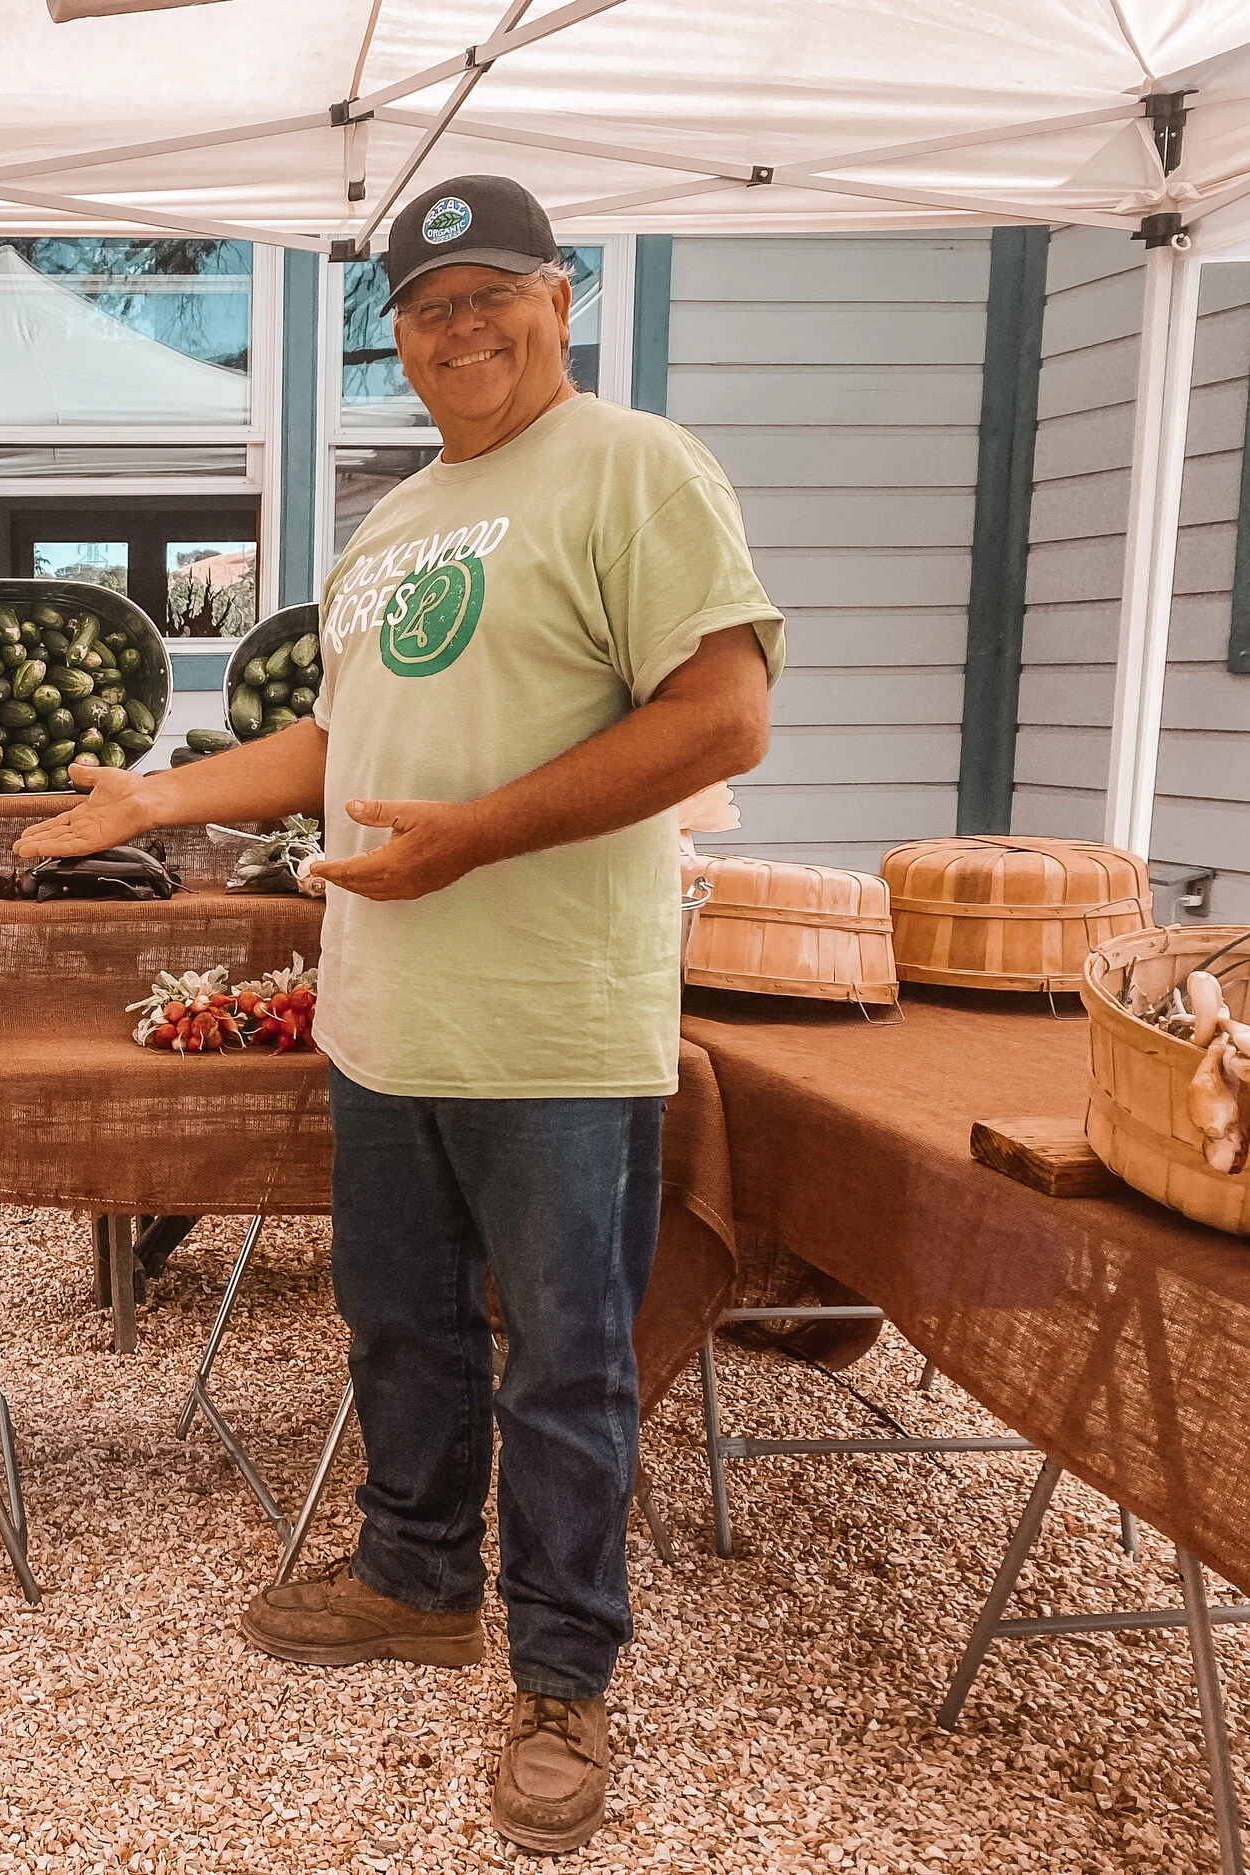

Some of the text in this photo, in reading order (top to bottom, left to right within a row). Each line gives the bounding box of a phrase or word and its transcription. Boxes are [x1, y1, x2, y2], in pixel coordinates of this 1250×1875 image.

[427, 200, 466, 226] REAL
[427, 219, 466, 238] ORGANIC
[343, 516, 510, 594] OCKEWOOD
[324, 583, 416, 654] ACRES
